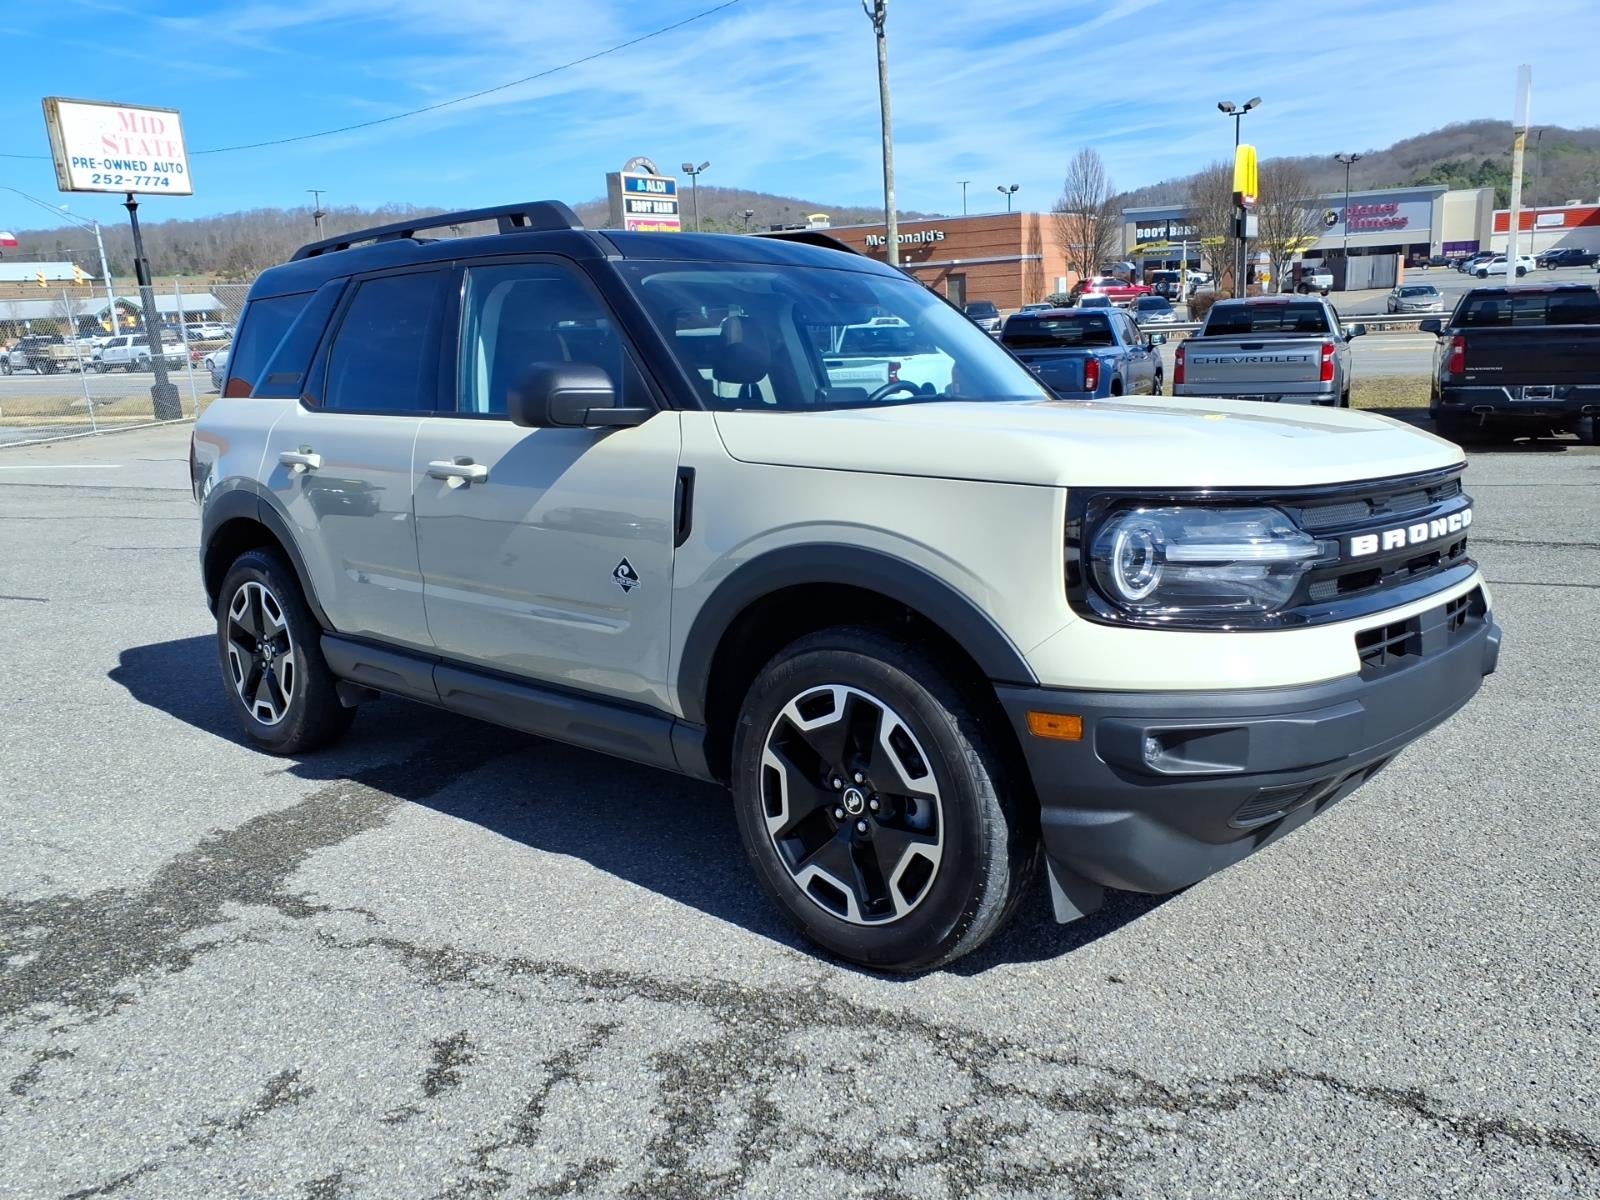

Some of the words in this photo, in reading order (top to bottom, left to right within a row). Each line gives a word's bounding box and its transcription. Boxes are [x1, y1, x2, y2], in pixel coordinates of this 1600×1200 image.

[117, 111, 165, 135] MID
[101, 133, 181, 158] STATE
[72, 156, 148, 171] PRE-OWNED
[153, 161, 183, 174] AUTO
[92, 173, 170, 187] 252-7774
[646, 179, 666, 193] ALDI
[866, 230, 945, 246] Mconald's
[1136, 227, 1167, 239] BOOT
[1193, 355, 1312, 365] CHEVROLET
[1350, 508, 1472, 557] BRONCO
